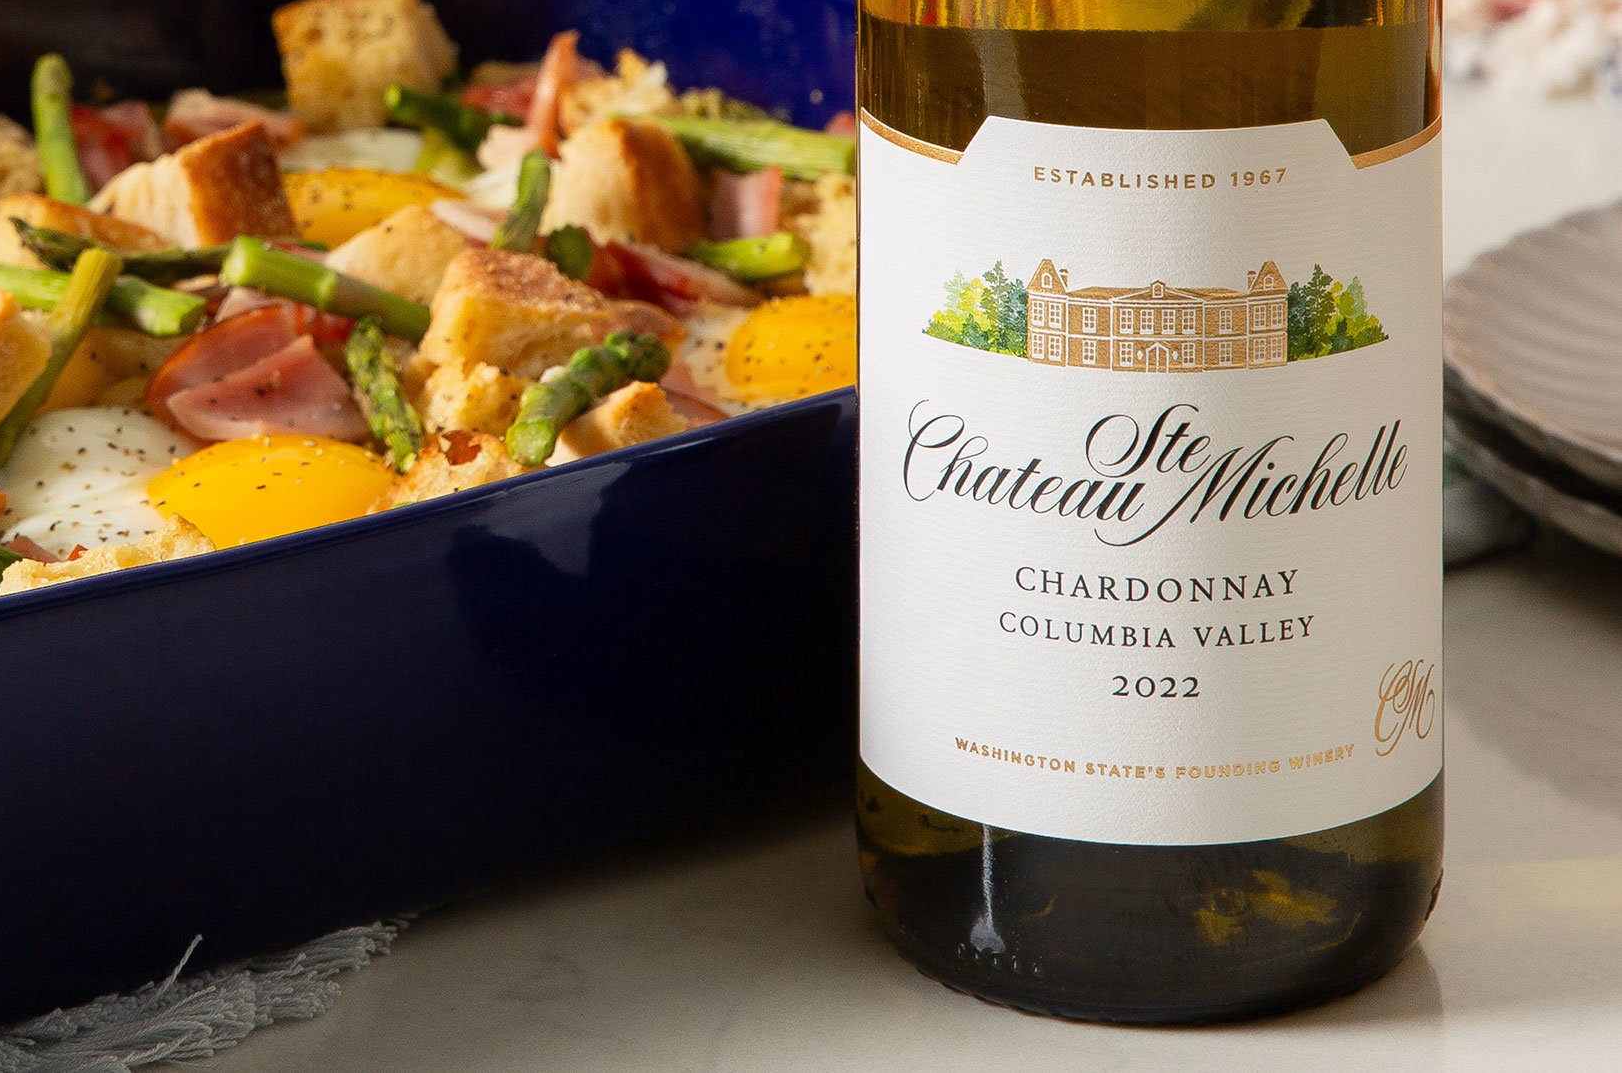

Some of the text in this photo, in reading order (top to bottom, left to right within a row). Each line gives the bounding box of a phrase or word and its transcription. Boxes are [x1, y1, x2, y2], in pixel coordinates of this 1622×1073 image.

[1033, 166, 1288, 190] ESTABLISHED 1967
[1085, 403, 1212, 479] Ste
[902, 399, 1409, 547] Chateau Michelle
[1014, 566, 1299, 604] CHARDONNAY
[998, 611, 1316, 649] COLUMBIA VALLEY
[1111, 675, 1201, 699] 2022
[954, 736, 1357, 780] WASHINGTON STATE'S FOUNDING WINERY
